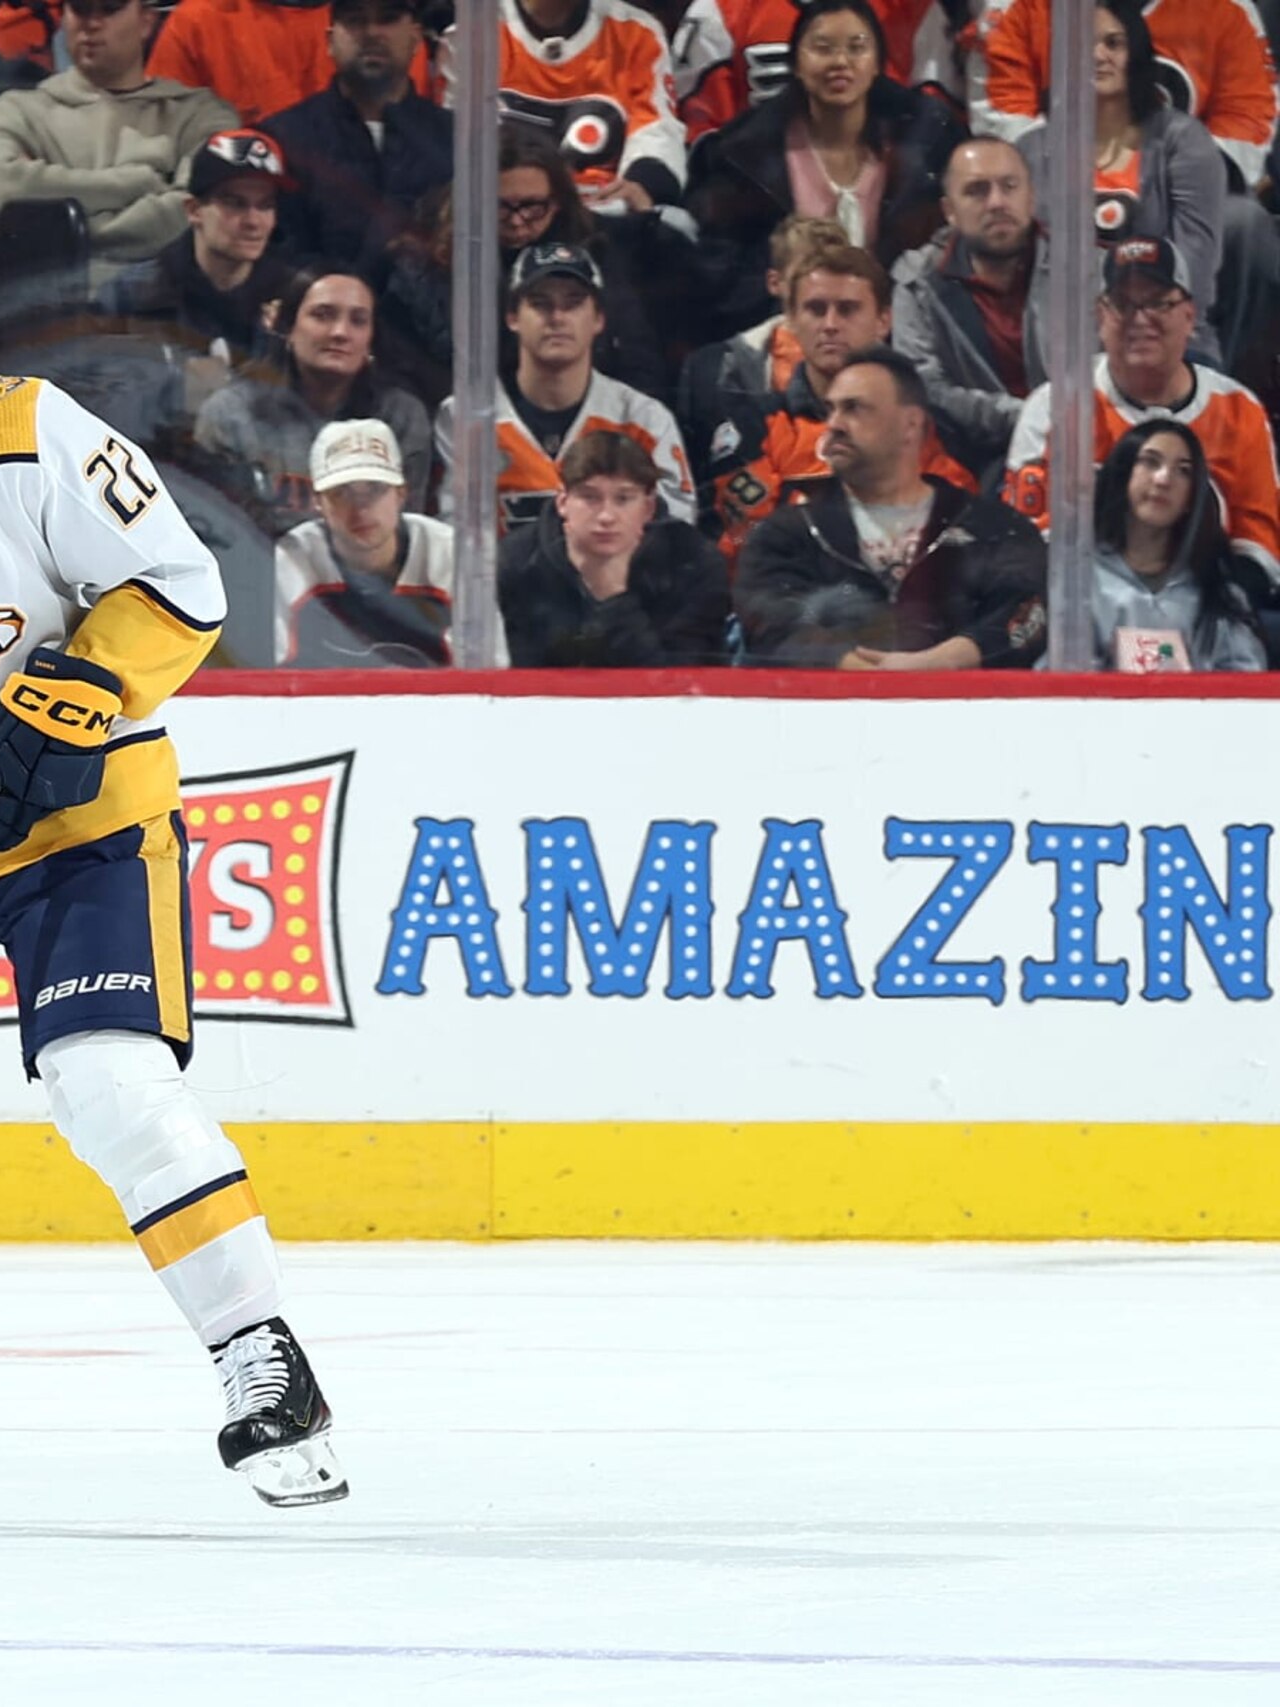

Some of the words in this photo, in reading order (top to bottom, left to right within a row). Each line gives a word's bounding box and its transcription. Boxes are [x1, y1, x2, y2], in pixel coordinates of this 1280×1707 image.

[82, 435, 160, 531] 22
[11, 683, 116, 735] CCM
[33, 972, 152, 1011] BAUER
